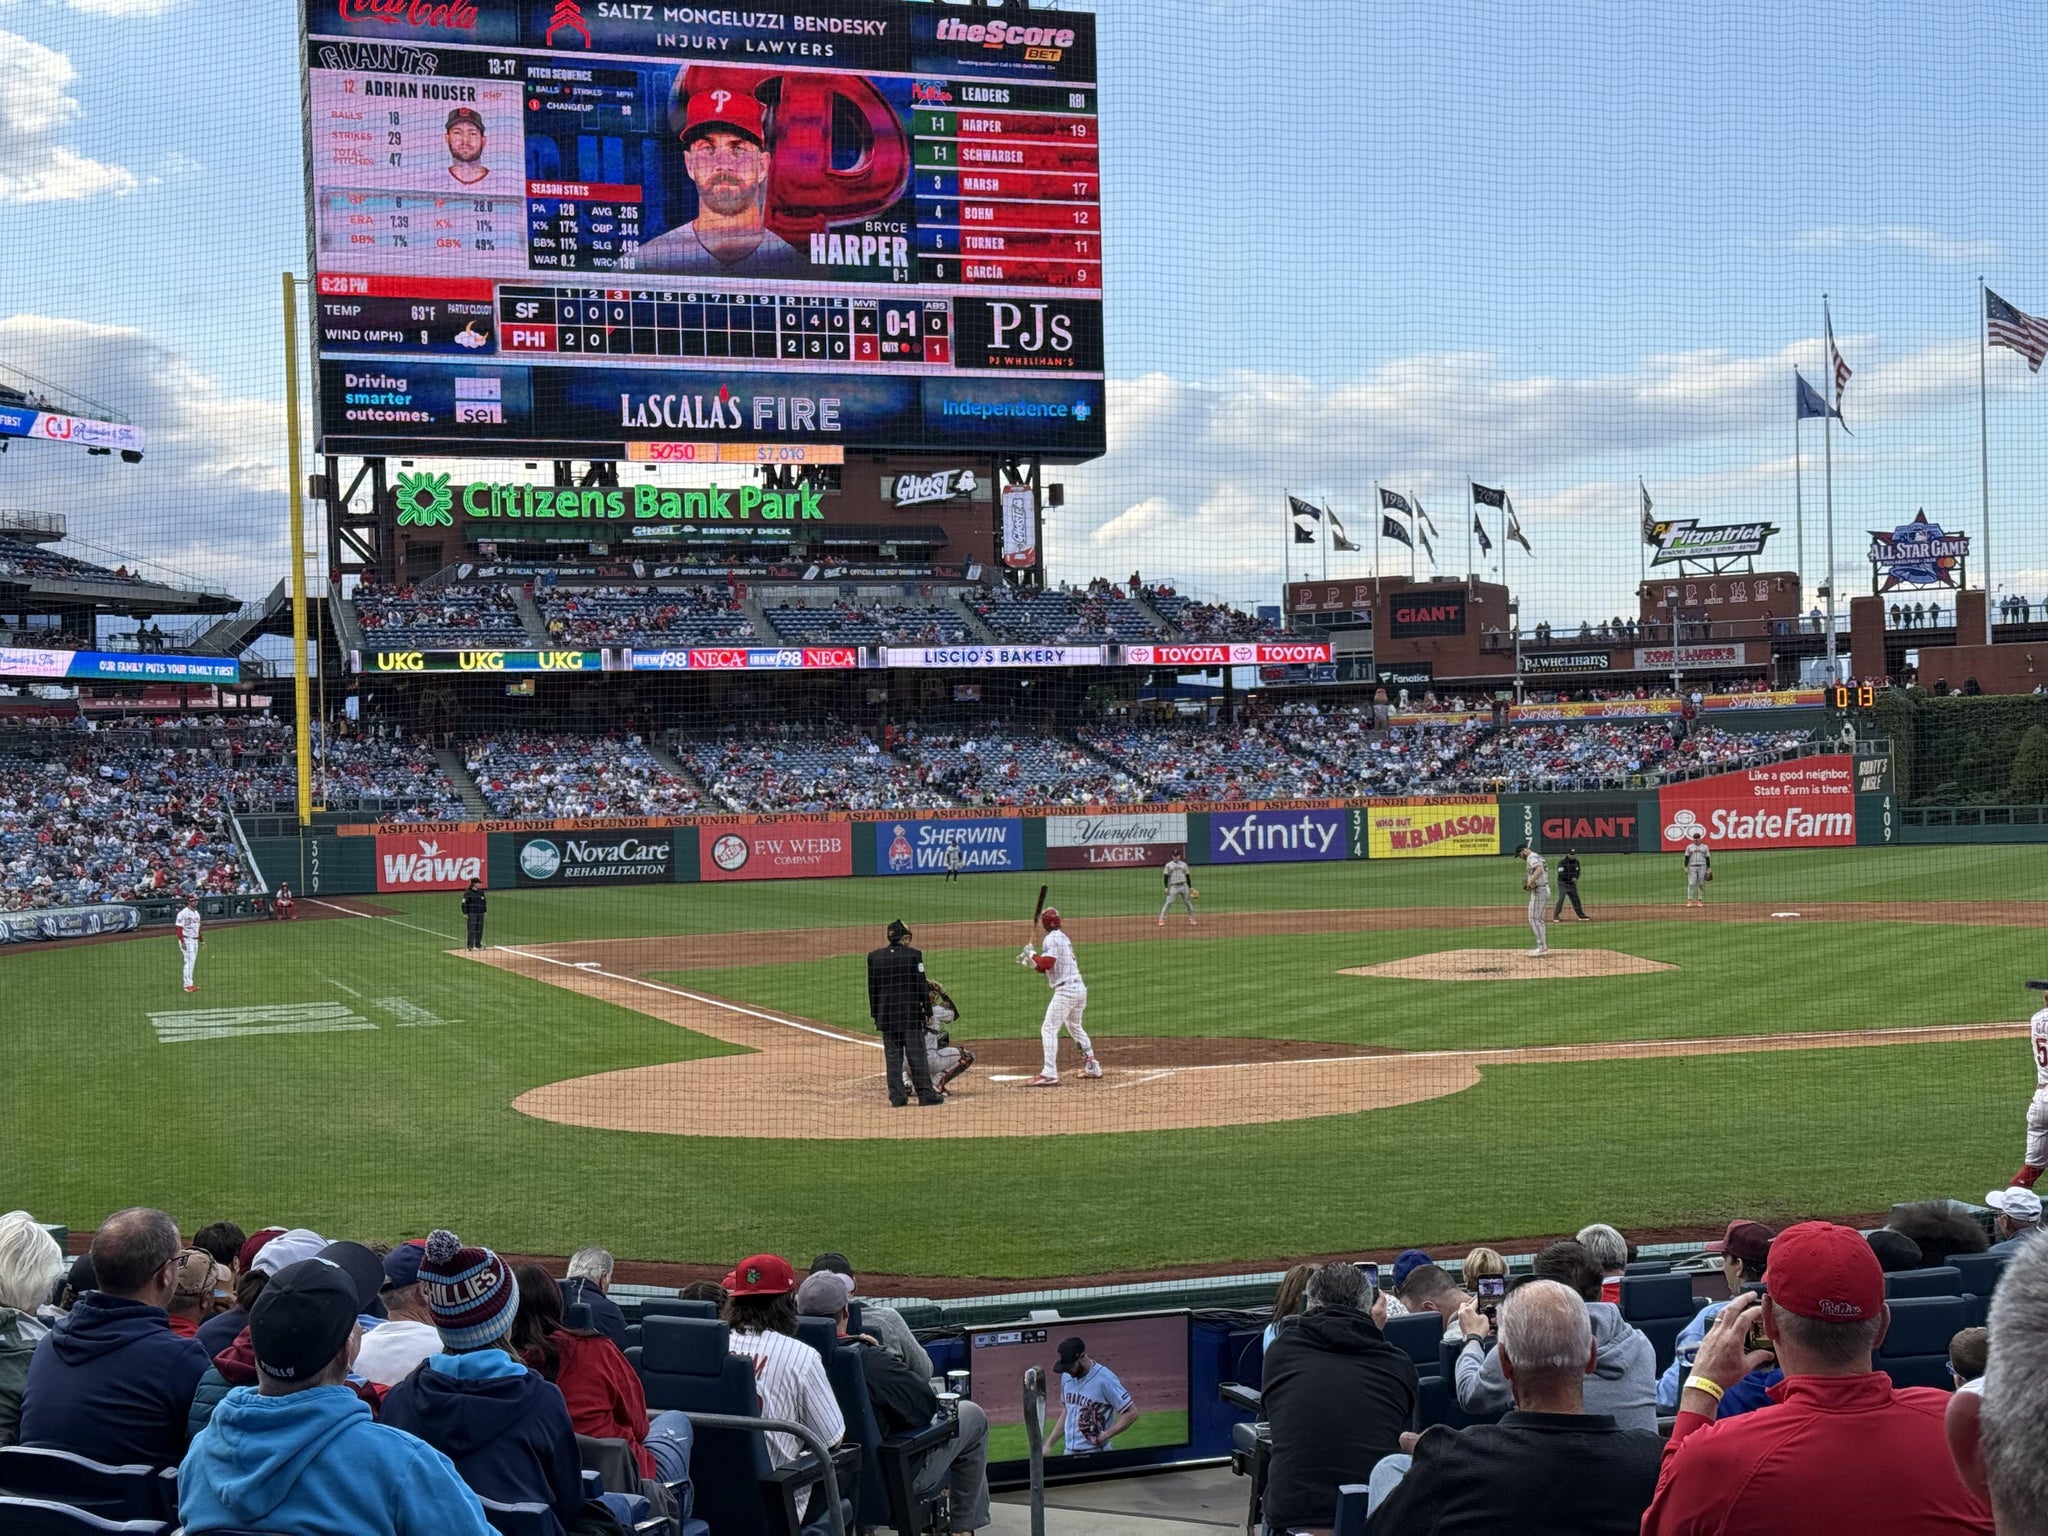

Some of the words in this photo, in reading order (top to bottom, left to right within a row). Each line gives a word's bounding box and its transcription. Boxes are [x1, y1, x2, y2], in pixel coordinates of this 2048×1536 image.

[598, 3, 653, 21] SALTZ
[664, 7, 785, 30] MONGELUZZI
[794, 16, 887, 36] BENDESKY
[936, 18, 1075, 48] theScore
[656, 33, 730, 50] INJURY
[746, 39, 834, 57] LAWYERS
[319, 43, 439, 76] GIANTS
[1028, 50, 1058, 59] BET
[488, 58, 516, 75] 13-17
[527, 67, 551, 79] PITCH
[553, 69, 593, 82] SEQUENCE
[343, 80, 355, 94] 12
[365, 80, 418, 98] ADRIAN
[422, 84, 476, 102] HOUSER
[536, 86, 560, 94] BALLS
[962, 87, 1010, 103] LEADERS
[1069, 94, 1085, 109] RBI
[547, 101, 594, 112] CHANGEUP
[332, 111, 362, 120] BALLS
[389, 111, 400, 125] 18
[962, 119, 1002, 133] HARPER
[1070, 125, 1086, 137] 19
[332, 131, 372, 141] STRIKES
[388, 131, 401, 145] 29
[389, 153, 401, 167] 47
[963, 149, 1023, 163] SCHWARBER
[564, 185, 589, 197] STATS
[964, 178, 999, 191] MARSH
[1072, 183, 1088, 195] 17
[532, 203, 546, 213] PA
[592, 207, 613, 216] AVG
[965, 207, 994, 220] BOHM
[1073, 211, 1089, 224] 12
[533, 221, 548, 230] K%
[559, 221, 578, 234] 17%
[592, 224, 613, 233] OBP
[865, 221, 908, 234] BRYCE
[533, 238, 556, 248] BB%
[560, 239, 578, 251] 11%
[592, 240, 612, 250] SLG
[810, 232, 909, 268] HARPER
[966, 236, 1005, 249] TURNER
[1075, 241, 1088, 253] 11
[534, 255, 557, 265] WAR
[966, 265, 1003, 279] GARCÍA
[350, 277, 368, 293] PM
[325, 305, 361, 316] TEMP
[854, 299, 876, 308] MVR
[926, 302, 946, 310] ABS
[515, 303, 539, 318] SF
[886, 309, 916, 337] 0-1
[986, 302, 1073, 352] PJs
[326, 329, 361, 340] WIND
[364, 330, 404, 343] (MPH)
[512, 331, 545, 348] PHI
[1004, 357, 1074, 367] WHELIHAN'S
[345, 373, 407, 391] Driving
[345, 393, 412, 406] smarter
[346, 408, 436, 423] outcomes.
[753, 396, 841, 431] FIRE
[943, 400, 1068, 420] Independence
[896, 469, 961, 506] GHOST
[462, 482, 626, 518] Citizens
[634, 482, 733, 519] Bank
[740, 481, 825, 519] Park
[702, 527, 754, 535] ENERGY
[757, 527, 792, 535] DECK
[1659, 521, 1764, 548] Fitzpatrick
[1869, 544, 1896, 560] ALL
[1896, 542, 1930, 559] STAR
[1931, 540, 1968, 557] GAME
[1754, 580, 1769, 597] 15
[1396, 605, 1458, 624] GIANT
[693, 651, 745, 667] NECA
[807, 649, 856, 666] NECA
[925, 650, 994, 664] LISCIO'S
[1000, 650, 1065, 663] BAKERY
[1159, 647, 1224, 662] TOYOTA
[1262, 646, 1326, 660] TOYOTA
[378, 652, 424, 671] UKG
[459, 652, 503, 670] UKG
[538, 652, 583, 670] UKG
[100, 660, 115, 671] OUR
[118, 661, 143, 673] FAMILY
[146, 662, 165, 674] PUTS
[167, 664, 187, 675] YOUR
[188, 665, 213, 676] FAMILY
[215, 666, 234, 677] FIRST
[1393, 674, 1430, 684] Fanatics
[1730, 695, 1773, 709] Surfside
[1836, 687, 1848, 708] 0
[1858, 686, 1874, 707] 13
[1518, 707, 1561, 720] Surfside
[1602, 703, 1647, 717] Surfside
[1748, 770, 1769, 781] Like
[1779, 770, 1803, 783] good
[1806, 769, 1850, 782] neighbor,
[1754, 785, 1780, 796] State
[1784, 785, 1809, 795] Farm
[1811, 784, 1819, 794] is
[1821, 784, 1848, 794] there.
[1183, 802, 1250, 811] ASPLUNDH
[1263, 800, 1330, 810] ASPLUNDH
[1344, 798, 1408, 807] ASPLUNDH
[1424, 796, 1488, 805] ASPLUNDH
[844, 811, 917, 822] ASPLUNDH
[931, 809, 1002, 820] ASPLUNDH
[1017, 807, 1088, 817] ASPLUNDH
[1101, 805, 1169, 814] ASPLUNDH
[571, 818, 649, 830] ASPLUNDH
[665, 816, 740, 827] ASPLUNDH
[756, 813, 829, 824] ASPLUNDH
[1375, 818, 1394, 828] WHO
[1396, 817, 1412, 827] BUT
[378, 823, 460, 835] ASPLUNDH
[476, 820, 556, 832] ASPLUNDH
[1073, 819, 1162, 844] Yuengling
[1542, 817, 1636, 839] GIANT
[917, 825, 1007, 846] SHERWIN
[1219, 814, 1338, 856] xfinity
[562, 838, 669, 863] NovaCare
[789, 837, 842, 854] WEBB
[774, 855, 822, 866] COMPANY
[1089, 847, 1146, 863] LAGER
[383, 853, 481, 884] Wawa
[564, 864, 666, 878] REHABILITATION
[1819, 1299, 1863, 1316] Phillies
